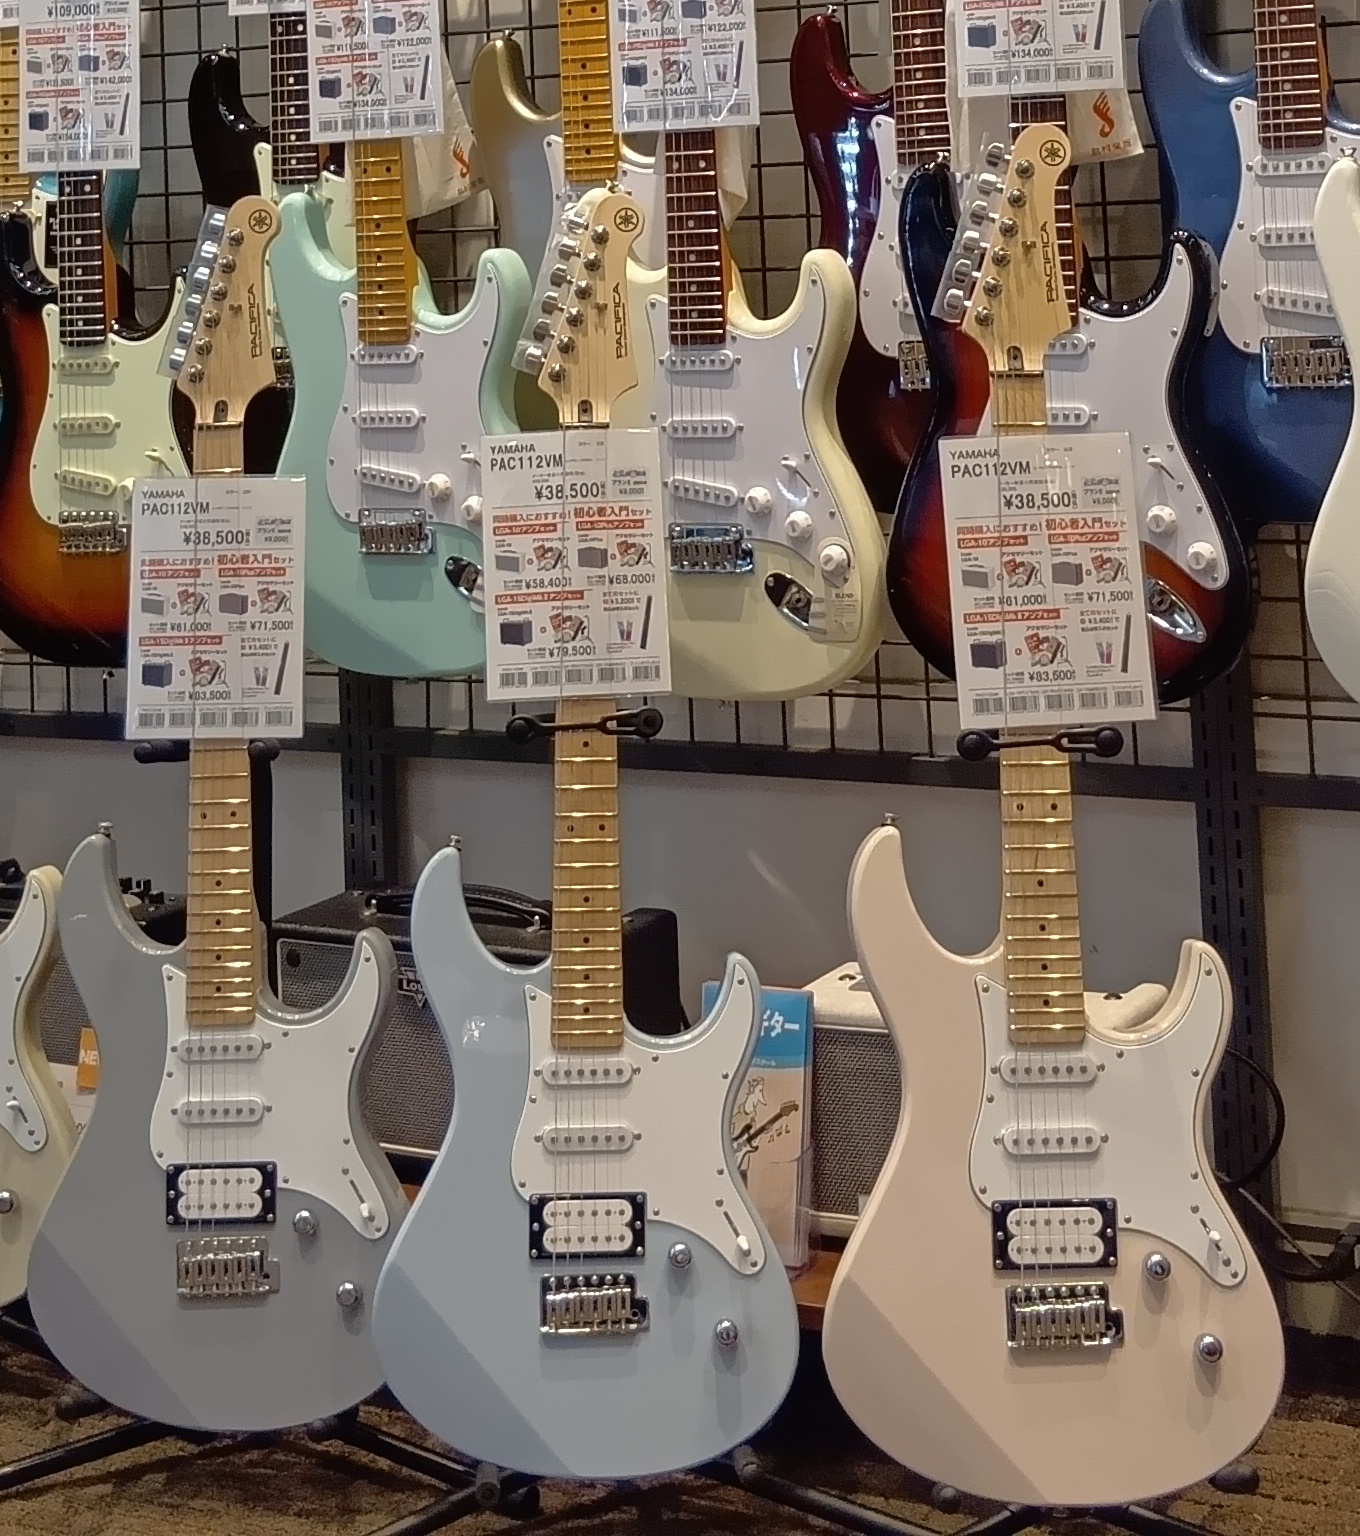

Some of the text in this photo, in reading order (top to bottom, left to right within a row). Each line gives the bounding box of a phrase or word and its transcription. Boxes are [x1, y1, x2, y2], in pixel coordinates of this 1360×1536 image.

[1041, 221, 1053, 305] PACIFICA
[248, 283, 256, 359] PACIFICA
[612, 282, 621, 358] PACIFICA
[490, 444, 536, 455] YAMAHA
[949, 449, 999, 460] YAMAHA
[490, 454, 563, 471] PAC112VM
[951, 462, 1030, 478] PAC112VM
[142, 490, 185, 499] YAMAHA
[534, 482, 600, 500] ¥38,500
[141, 502, 210, 515] PAC112VM
[1003, 492, 1071, 510] ¥38,500
[1087, 591, 1129, 603] ¥71,500
[250, 620, 290, 631] ¥71,500
